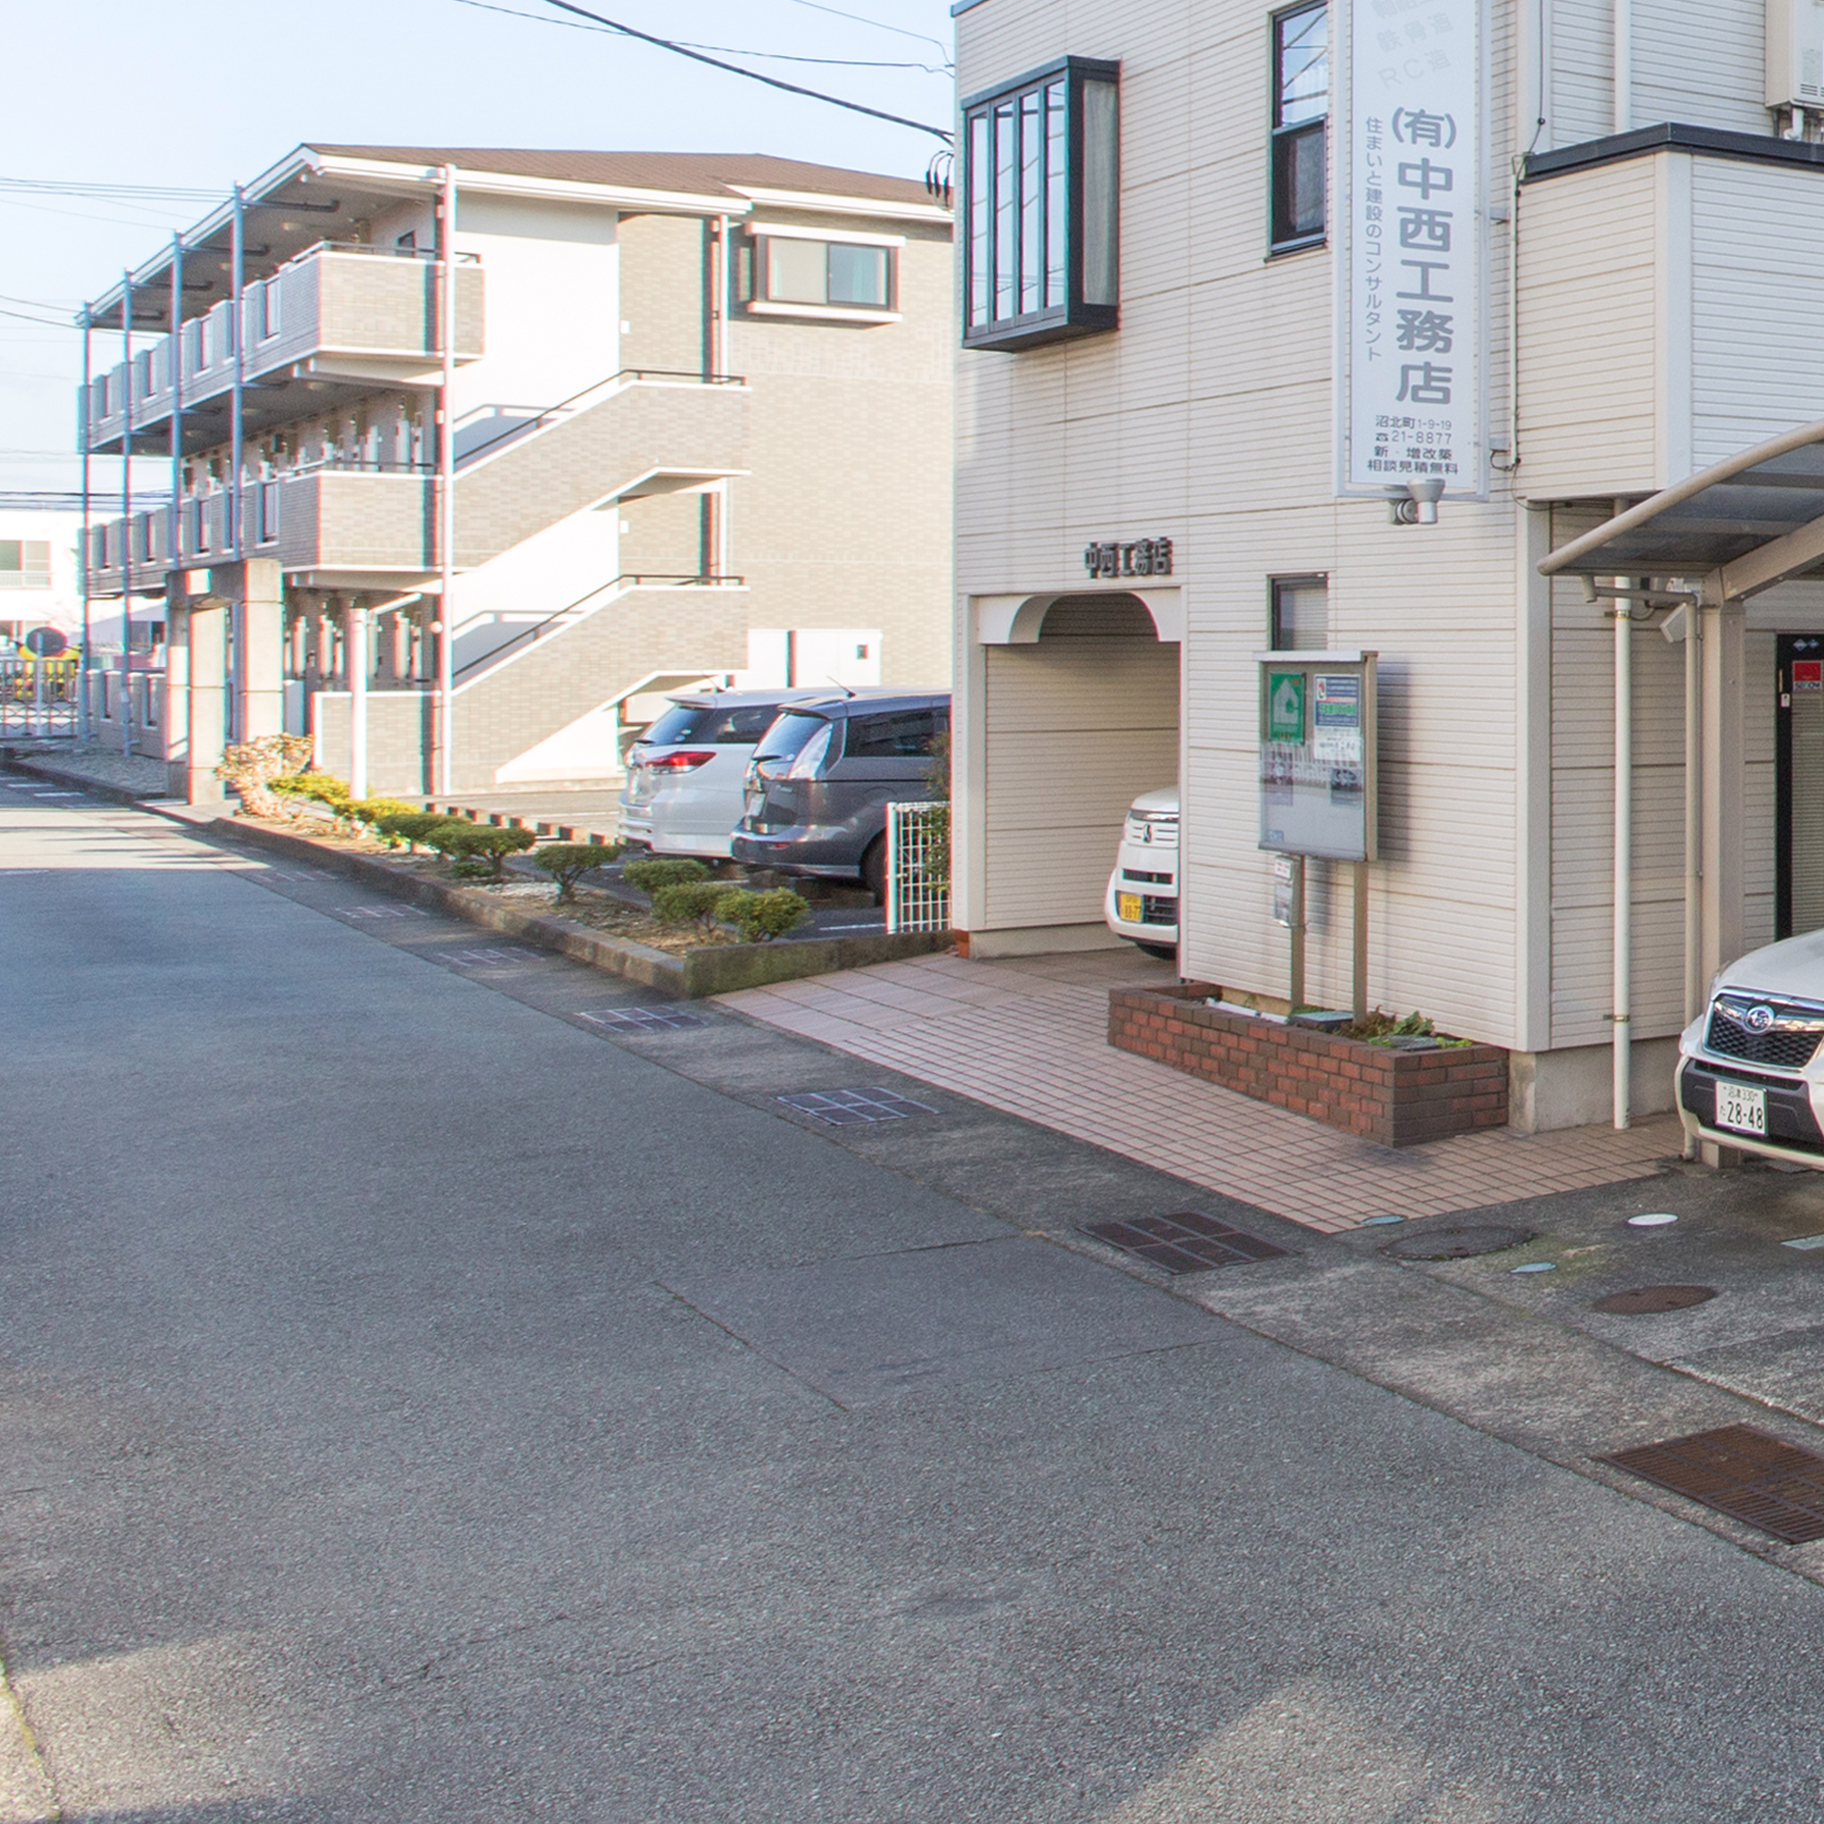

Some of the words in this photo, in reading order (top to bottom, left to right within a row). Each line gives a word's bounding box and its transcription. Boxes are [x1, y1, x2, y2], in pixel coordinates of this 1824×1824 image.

[1365, 116, 1383, 362] 住まいと建設のコンサルタント
[1084, 537, 1173, 579] 中西工務店
[1727, 1100, 1763, 1129] 28-48
